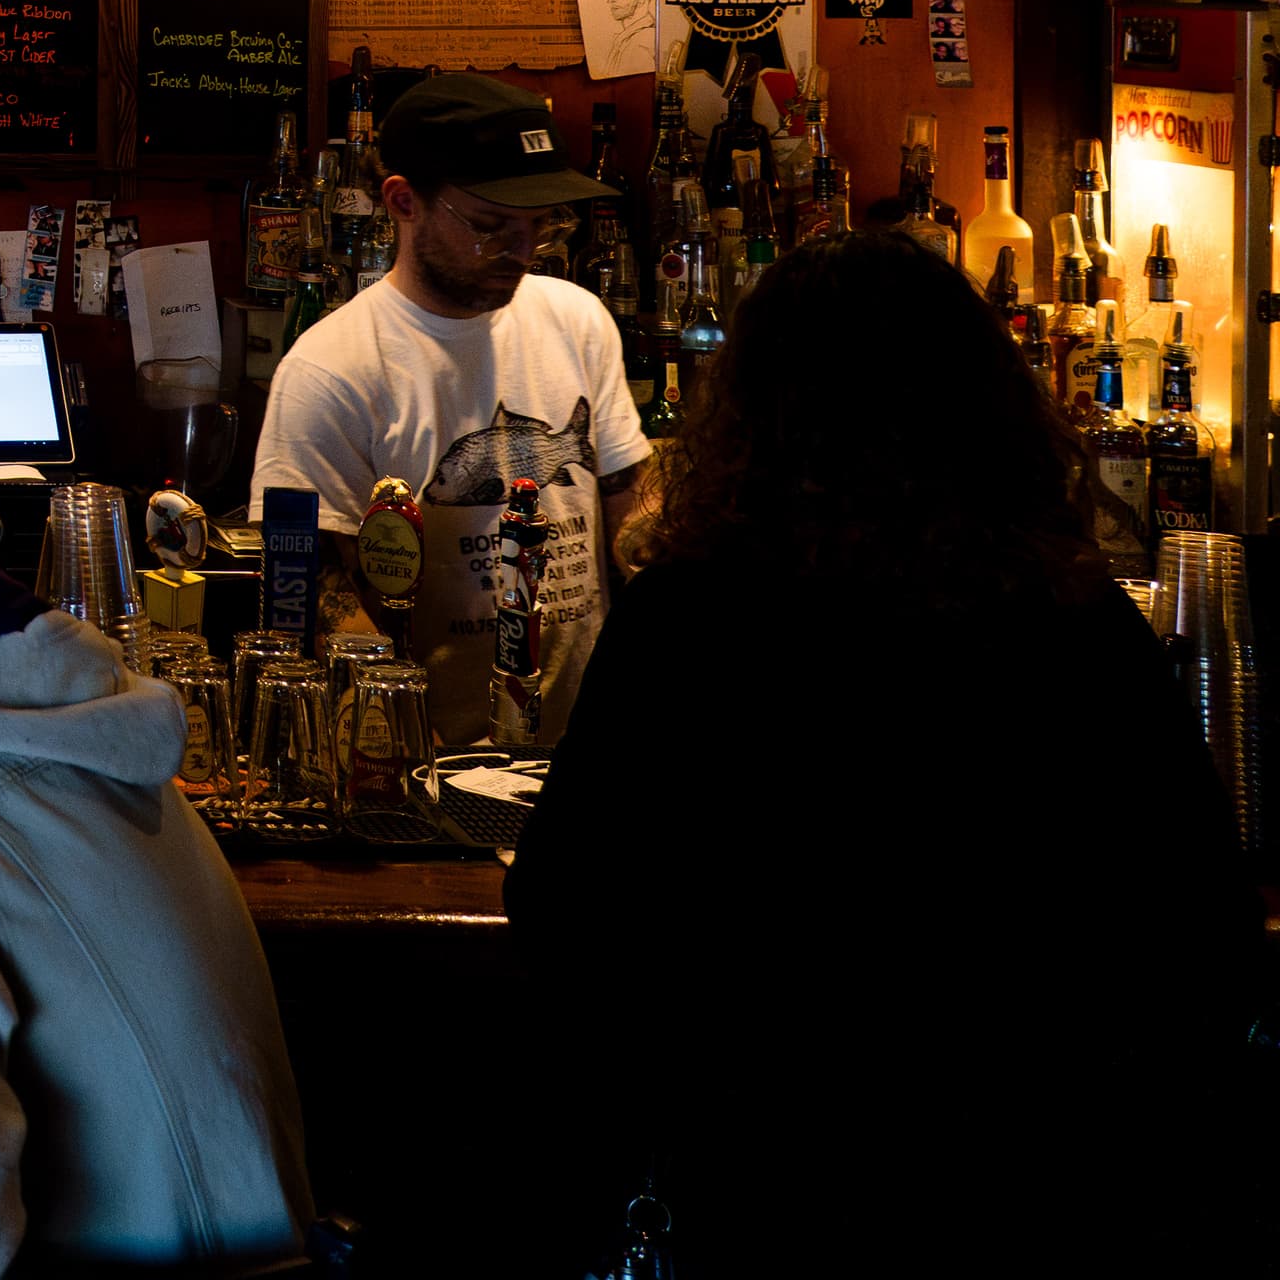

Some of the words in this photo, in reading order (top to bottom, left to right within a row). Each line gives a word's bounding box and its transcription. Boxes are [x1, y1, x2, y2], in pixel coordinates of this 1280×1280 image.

[713, 8, 757, 17] BEER
[21, 44, 55, 64] CIDER
[1115, 110, 1203, 153] POPCORN
[1155, 510, 1208, 528] VODKA
[270, 534, 314, 553] CIDER
[366, 562, 413, 580] LAGER
